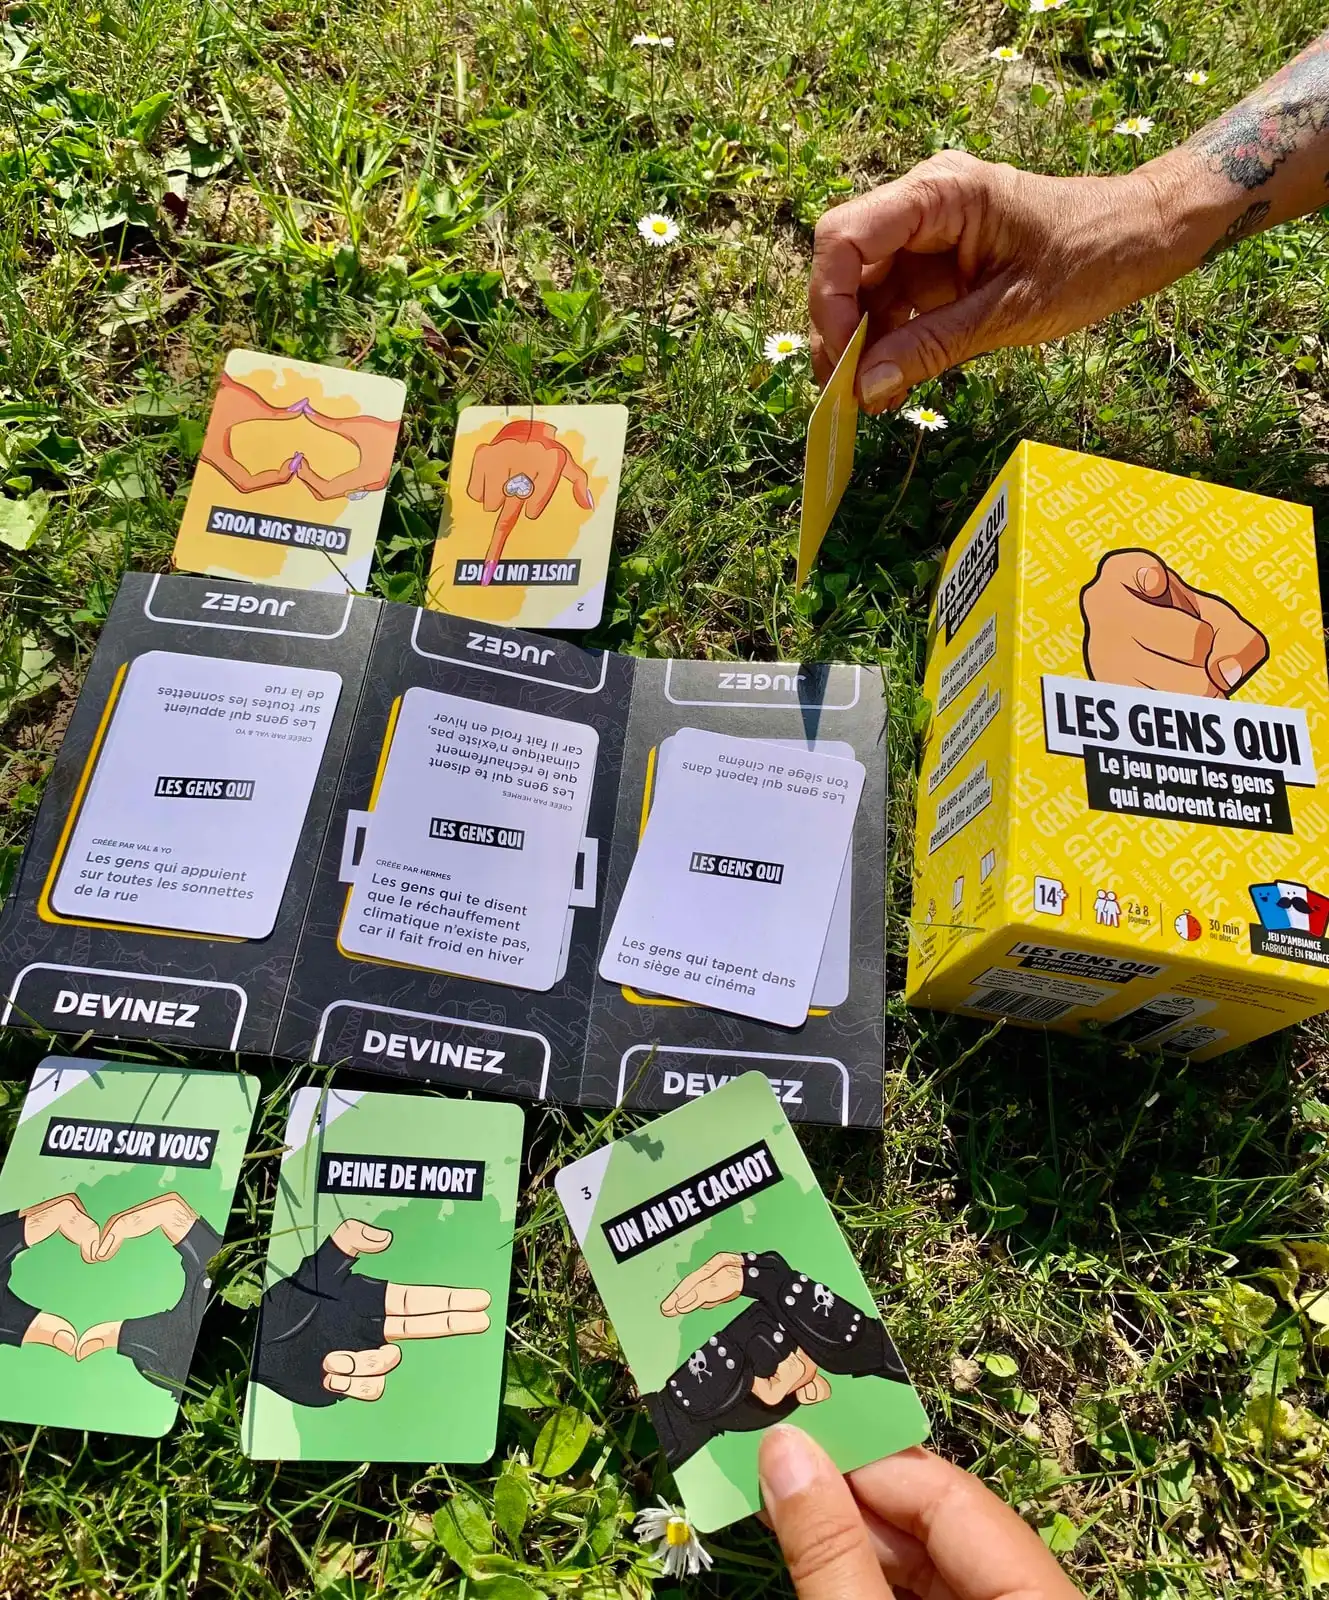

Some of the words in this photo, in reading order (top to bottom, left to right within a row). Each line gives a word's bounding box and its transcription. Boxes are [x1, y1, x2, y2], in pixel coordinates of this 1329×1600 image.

[212, 512, 256, 535] VOUS
[259, 519, 292, 540] SUR
[294, 525, 346, 549] COEUR
[940, 574, 956, 614] LES
[958, 530, 983, 586] GENS
[986, 494, 1004, 543] QUI
[458, 564, 504, 581] DIGT
[508, 564, 529, 581] UN
[531, 564, 576, 581] JUSTE
[202, 592, 296, 617] JUGEZ
[577, 603, 584, 611] 2
[466, 632, 555, 666] JUGEZ
[264, 685, 287, 695] rue
[718, 673, 806, 692] JUGEZ
[157, 687, 225, 702] sonnettes
[228, 696, 248, 708] les
[291, 688, 303, 699] la
[307, 690, 324, 701] de
[164, 703, 226, 718] appuient
[252, 699, 295, 712] toutes
[298, 704, 320, 714] sur
[228, 710, 252, 721] qui
[256, 714, 289, 725] gens
[293, 718, 316, 730] Les
[434, 713, 468, 730] hiver
[428, 725, 455, 739] pas,
[471, 722, 488, 732] en
[491, 727, 522, 743] froid
[1055, 692, 1120, 742] LES
[1128, 704, 1226, 756] GENS
[1234, 718, 1302, 766] QUI
[526, 735, 547, 749] fait
[551, 742, 559, 752] il
[562, 745, 583, 755] car
[428, 757, 471, 775] disent
[436, 743, 533, 774] réchauffement
[512, 747, 580, 770] climatique
[718, 754, 764, 771] cinéma
[474, 768, 488, 780] te
[537, 768, 549, 780] le
[553, 772, 577, 783] que
[682, 762, 712, 776] dans
[715, 769, 758, 786] tapent
[768, 765, 784, 775] au
[787, 769, 823, 784] siège
[1098, 752, 1120, 775] Le
[1122, 755, 1152, 781] jeu
[1156, 763, 1199, 786] pour
[1202, 766, 1228, 789] les
[1231, 773, 1276, 796] gens
[492, 772, 513, 784] qui
[517, 778, 548, 792] gens
[762, 778, 783, 789] qui
[827, 777, 848, 789] ton
[157, 779, 183, 795] LES
[185, 780, 223, 797] GENS
[225, 782, 252, 798] QUI
[553, 787, 574, 800] Les
[786, 783, 819, 796] gens
[533, 798, 548, 806] PAR
[822, 791, 845, 804] Les
[1109, 786, 1139, 809] qui
[1144, 791, 1217, 818] adorent
[1218, 800, 1262, 824] râler
[431, 820, 456, 838] LES
[459, 824, 494, 843] GENS
[497, 830, 523, 849] QUI
[92, 838, 118, 847] CRÉÉE
[137, 844, 151, 852] VAL
[85, 851, 111, 865] Les
[114, 858, 150, 870] gens
[154, 862, 178, 874] qui
[181, 866, 247, 882] appuient
[376, 859, 401, 870] CRÉÉE
[402, 865, 419, 873] PAR
[420, 868, 451, 880] HERMES
[692, 854, 716, 872] LES
[718, 858, 753, 877] GENS
[756, 864, 782, 883] QUI
[74, 884, 93, 896] de
[97, 886, 110, 898] la
[114, 891, 138, 902] rue
[79, 870, 104, 880] sur
[107, 871, 153, 887] toutes
[156, 877, 178, 890] les
[181, 883, 254, 899] sonnettes
[372, 873, 396, 888] Les
[400, 882, 435, 896] gens
[439, 890, 462, 902] qui
[466, 894, 480, 906] te
[484, 898, 527, 916] disent
[367, 891, 395, 904] que
[399, 895, 412, 908] le
[416, 900, 520, 931] réchauffement
[1128, 903, 1133, 913] 2
[1144, 906, 1149, 916] 8
[363, 906, 440, 931] climatique
[502, 937, 530, 952] pas,
[1209, 919, 1220, 931] 30
[1223, 924, 1240, 935] min
[358, 924, 383, 936] car
[386, 927, 395, 939] il
[399, 930, 424, 945] fait
[428, 936, 462, 953] froid
[466, 946, 484, 957] en
[488, 948, 524, 965] hiver
[1268, 932, 1280, 941] JEU
[1281, 934, 1322, 950] D'AMBIANCE
[622, 936, 645, 951] Les
[648, 945, 682, 960] gens
[686, 954, 708, 966] qui
[712, 958, 758, 979] tapent
[762, 971, 796, 988] dans
[1018, 945, 1058, 957] LES
[1060, 952, 1118, 967] GENS
[1119, 962, 1160, 975] QUI
[1295, 949, 1304, 958] EN
[1305, 951, 1329, 963] FRANCE
[617, 952, 639, 966] ton
[643, 959, 680, 976] siège
[684, 970, 701, 982] au
[705, 975, 756, 996] cinéma
[54, 990, 200, 1028] DEVINEZ
[363, 1030, 506, 1074] DEVINEZ
[54, 1080, 60, 1092] 1
[663, 1072, 803, 1104] DEVEZ
[49, 1124, 113, 1153] COEUR
[114, 1130, 156, 1157] SUR
[158, 1133, 212, 1162] VOUS
[327, 1160, 387, 1189] PEINE
[390, 1164, 418, 1190] DE
[420, 1166, 476, 1193] MORT
[581, 1187, 592, 1200] 3
[609, 1218, 645, 1252] UN
[641, 1202, 674, 1240] AN
[669, 1187, 702, 1224] DE
[697, 1150, 773, 1208] CACHOT
